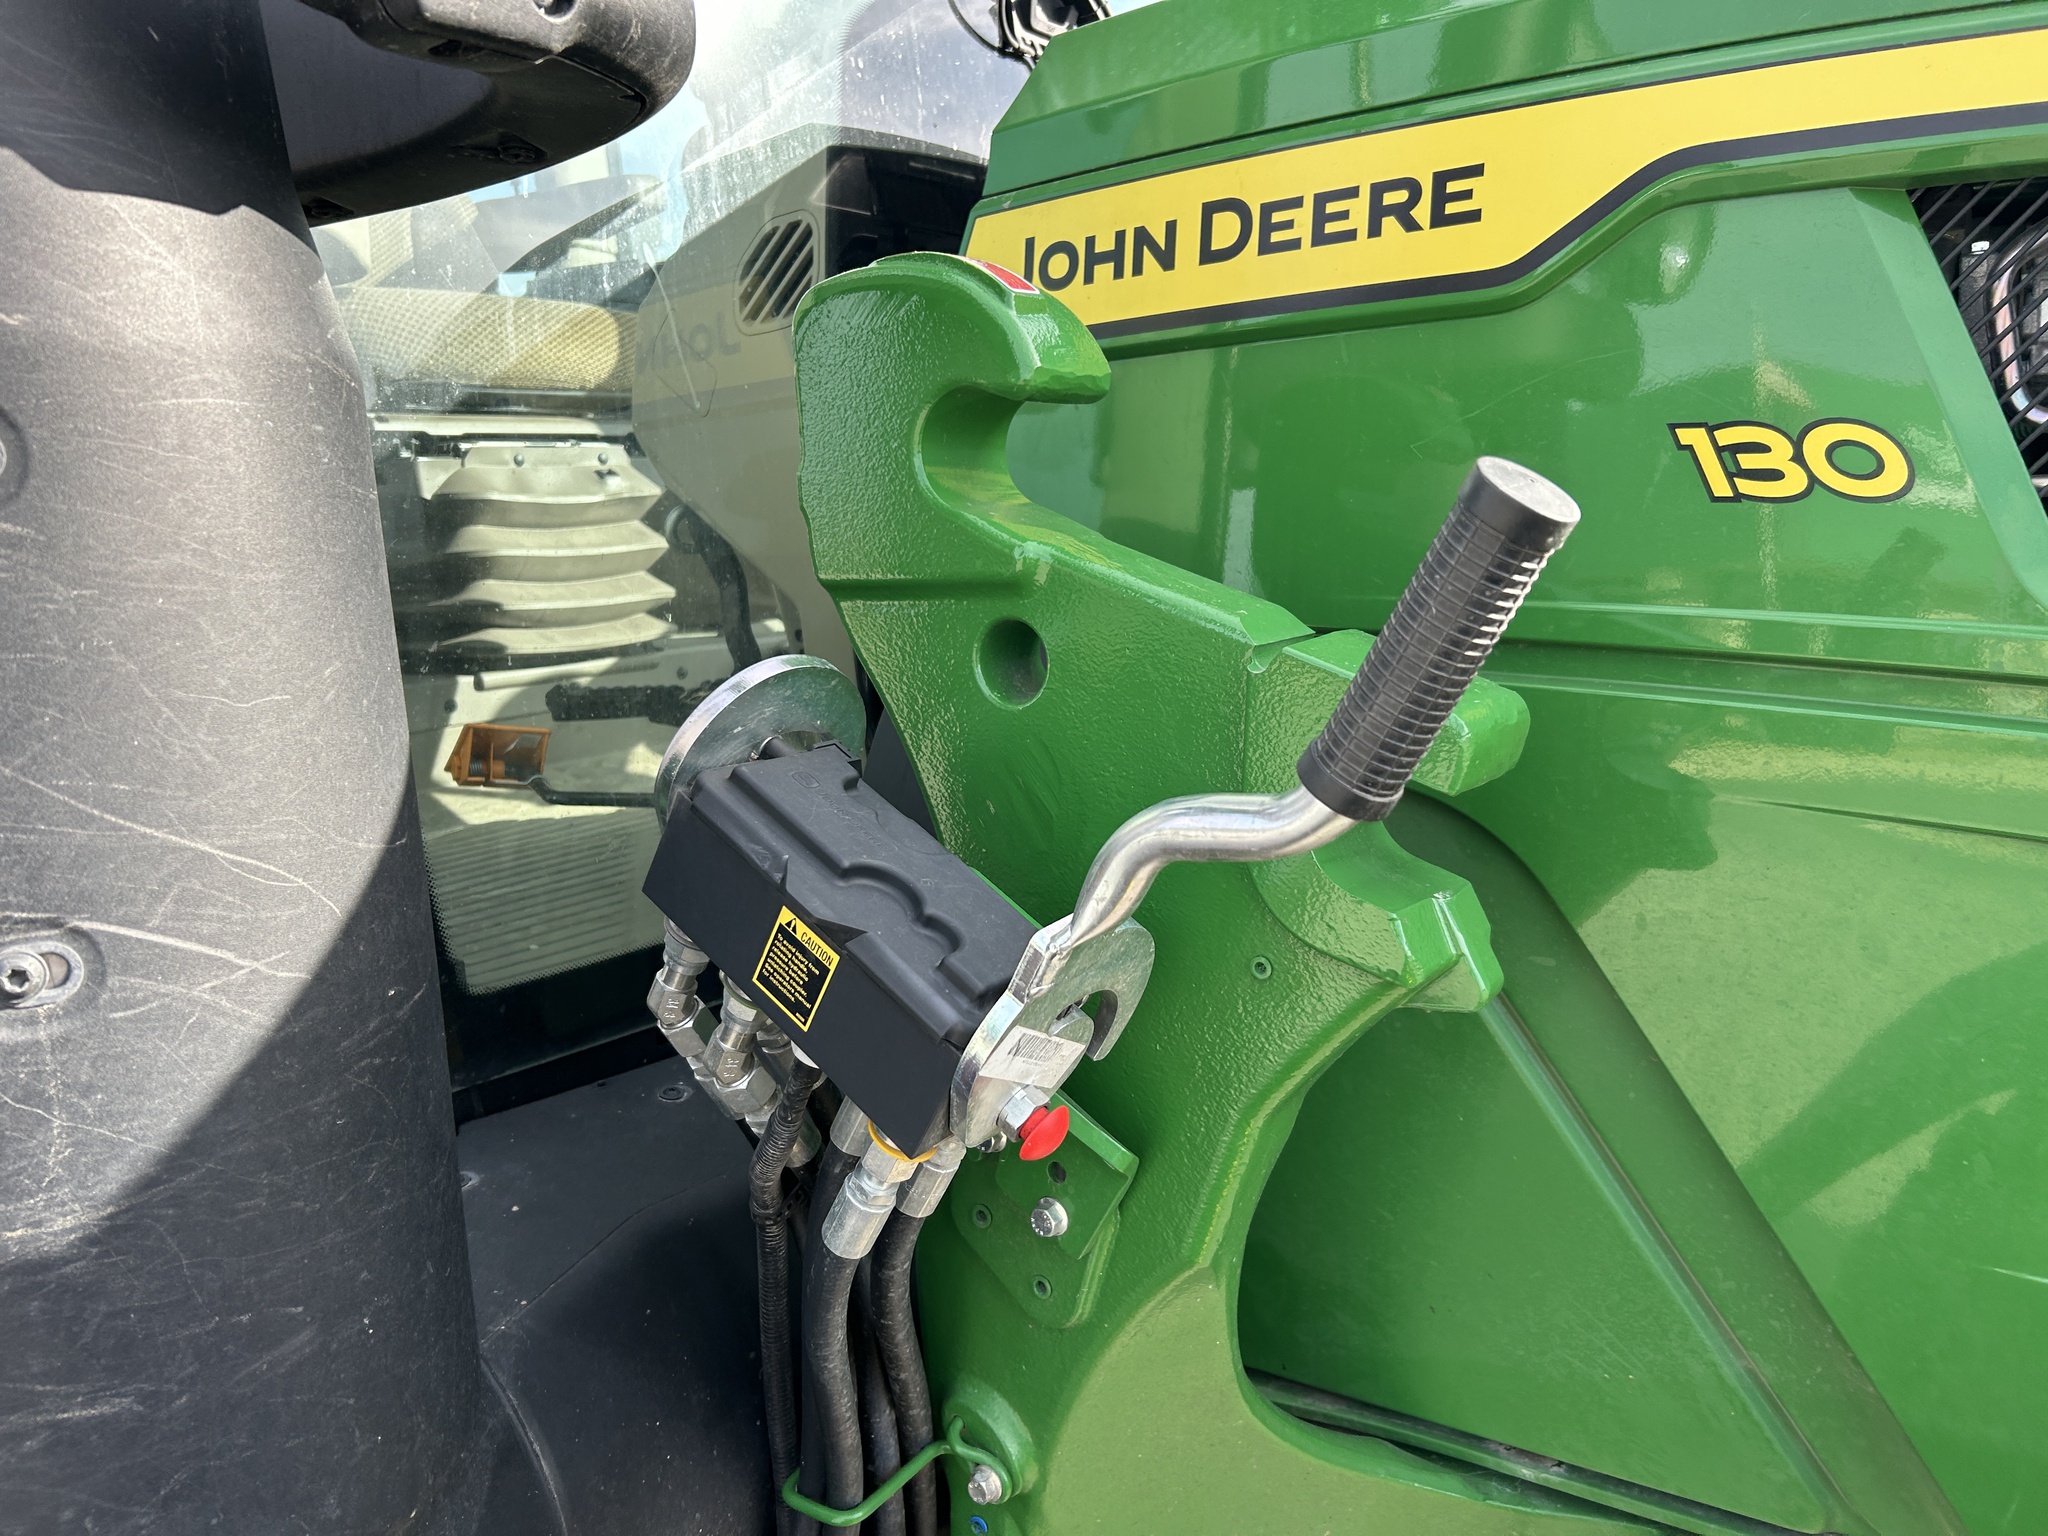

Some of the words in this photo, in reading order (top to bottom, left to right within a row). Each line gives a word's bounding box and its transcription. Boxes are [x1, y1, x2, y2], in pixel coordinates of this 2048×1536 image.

[1024, 218, 1178, 291] JOHN
[1199, 162, 1486, 266] DEERE
[1666, 417, 1916, 504] 130
[776, 932, 784, 941] To
[782, 937, 796, 953] avoid
[794, 949, 809, 966] injury
[799, 931, 834, 967] CAUTION
